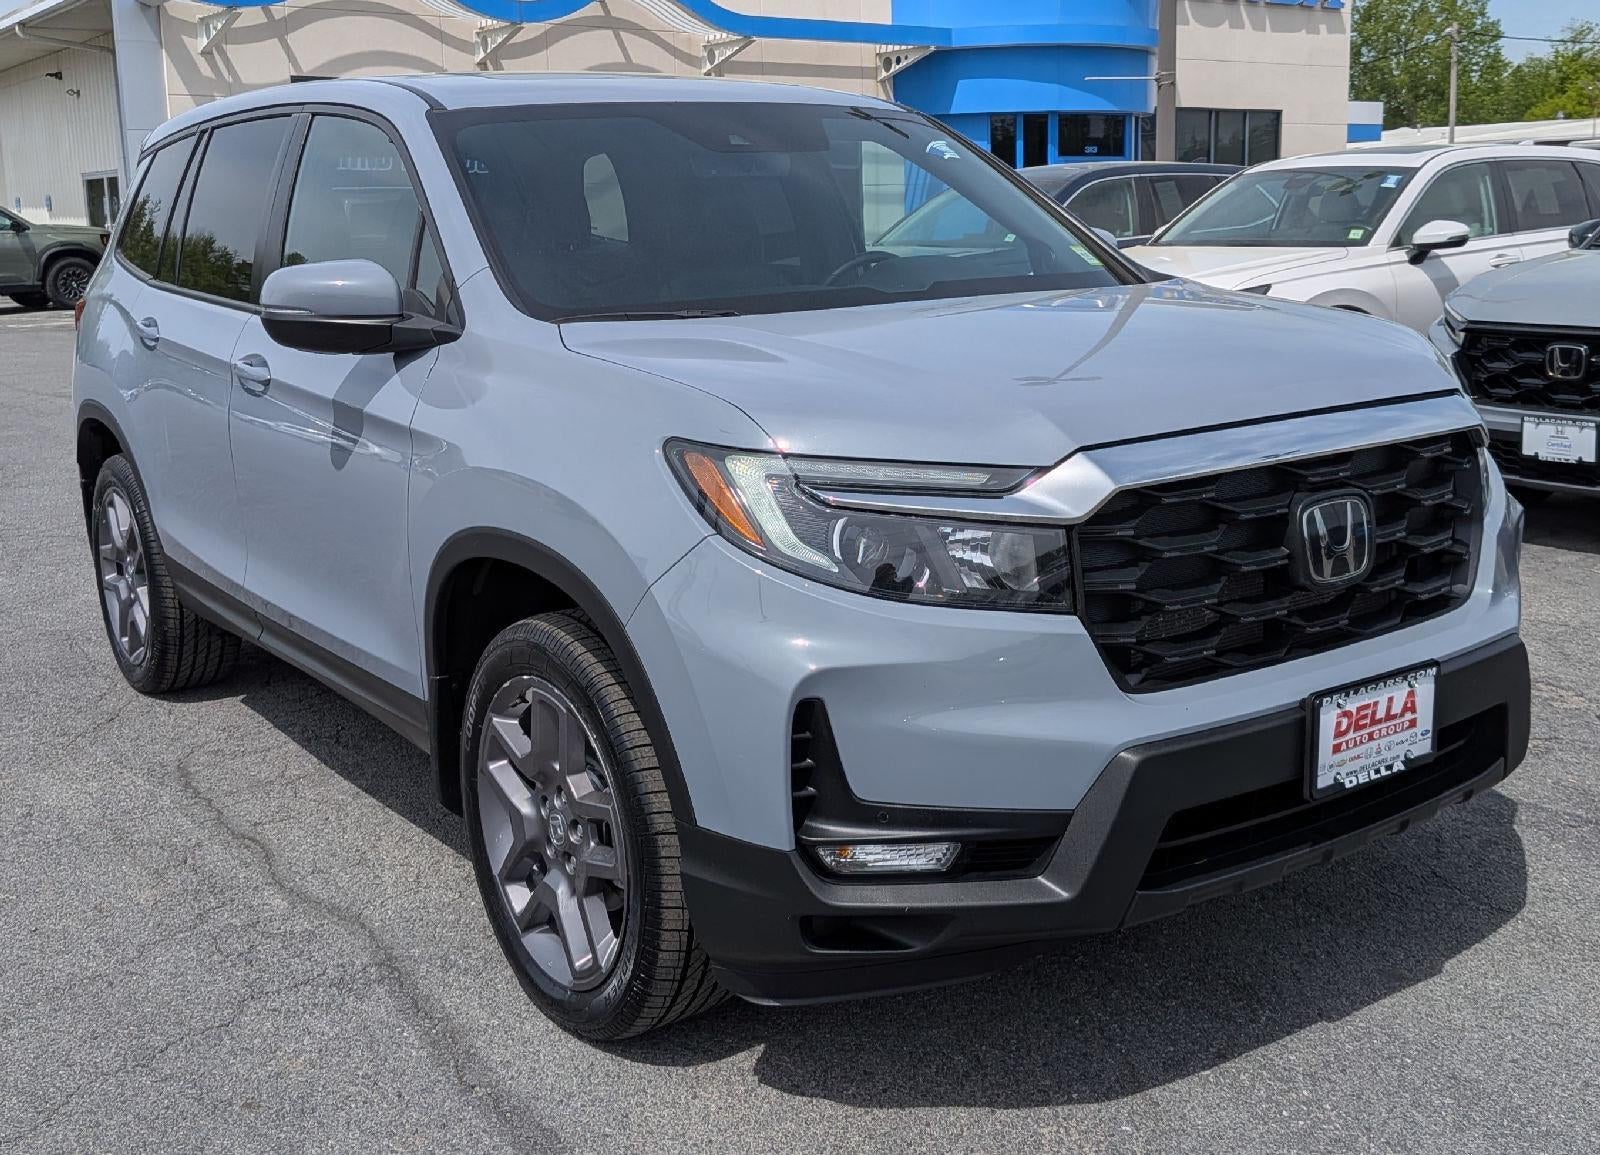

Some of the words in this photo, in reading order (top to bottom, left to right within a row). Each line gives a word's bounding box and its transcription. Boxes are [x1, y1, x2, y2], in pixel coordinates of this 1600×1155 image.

[1321, 667, 1438, 708] DELLACARS.COM
[1333, 688, 1418, 741] DELLA
[1340, 733, 1369, 752] AUTO
[1372, 720, 1410, 740] GROUP
[1343, 760, 1406, 789] DELLA
